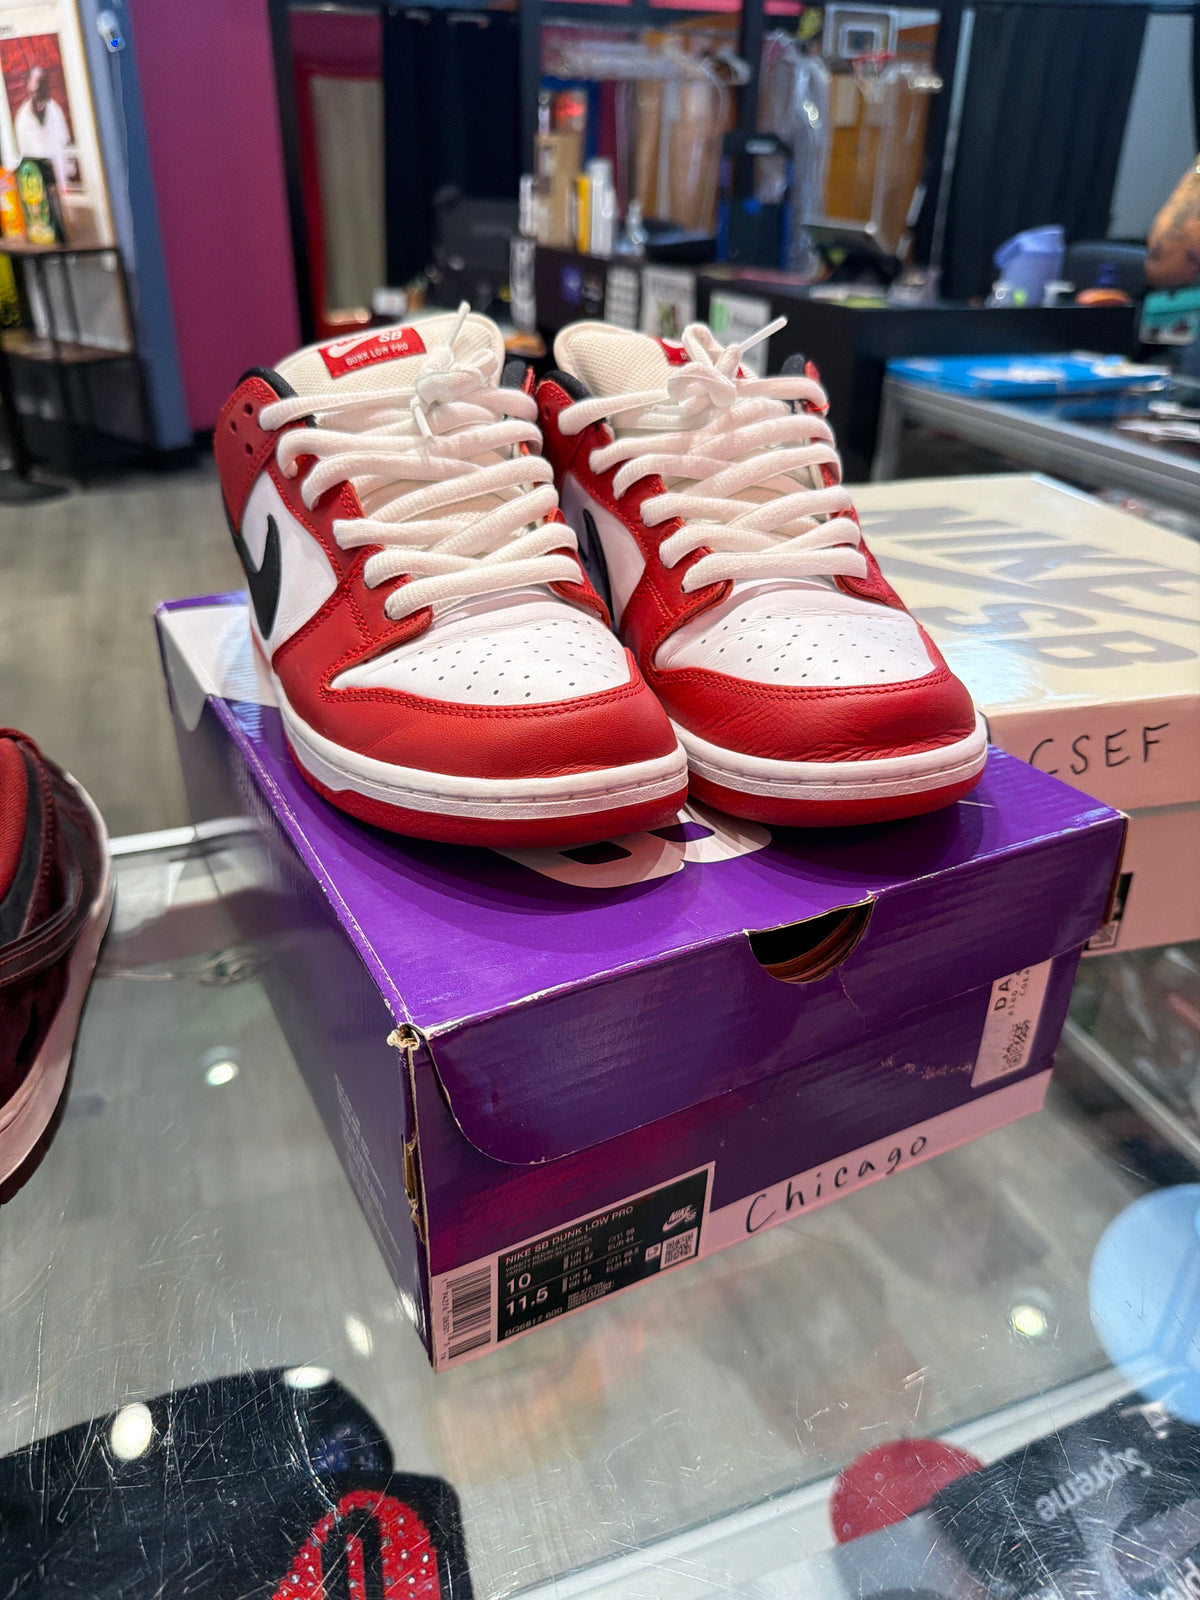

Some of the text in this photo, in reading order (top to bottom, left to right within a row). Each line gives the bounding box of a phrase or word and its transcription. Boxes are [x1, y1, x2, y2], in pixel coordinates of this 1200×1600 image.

[378, 330, 403, 342] SB
[345, 341, 409, 366] DUNK LOW PRO
[1027, 722, 1172, 776] CSEF
[744, 1135, 928, 1235] Chicago
[669, 1205, 692, 1223] NIKE
[505, 1205, 634, 1265] NIKE SB DUNK LOW PRO
[506, 1273, 531, 1294] 10
[505, 1287, 548, 1316] 11.5
[1035, 1446, 1154, 1522] Supreme
